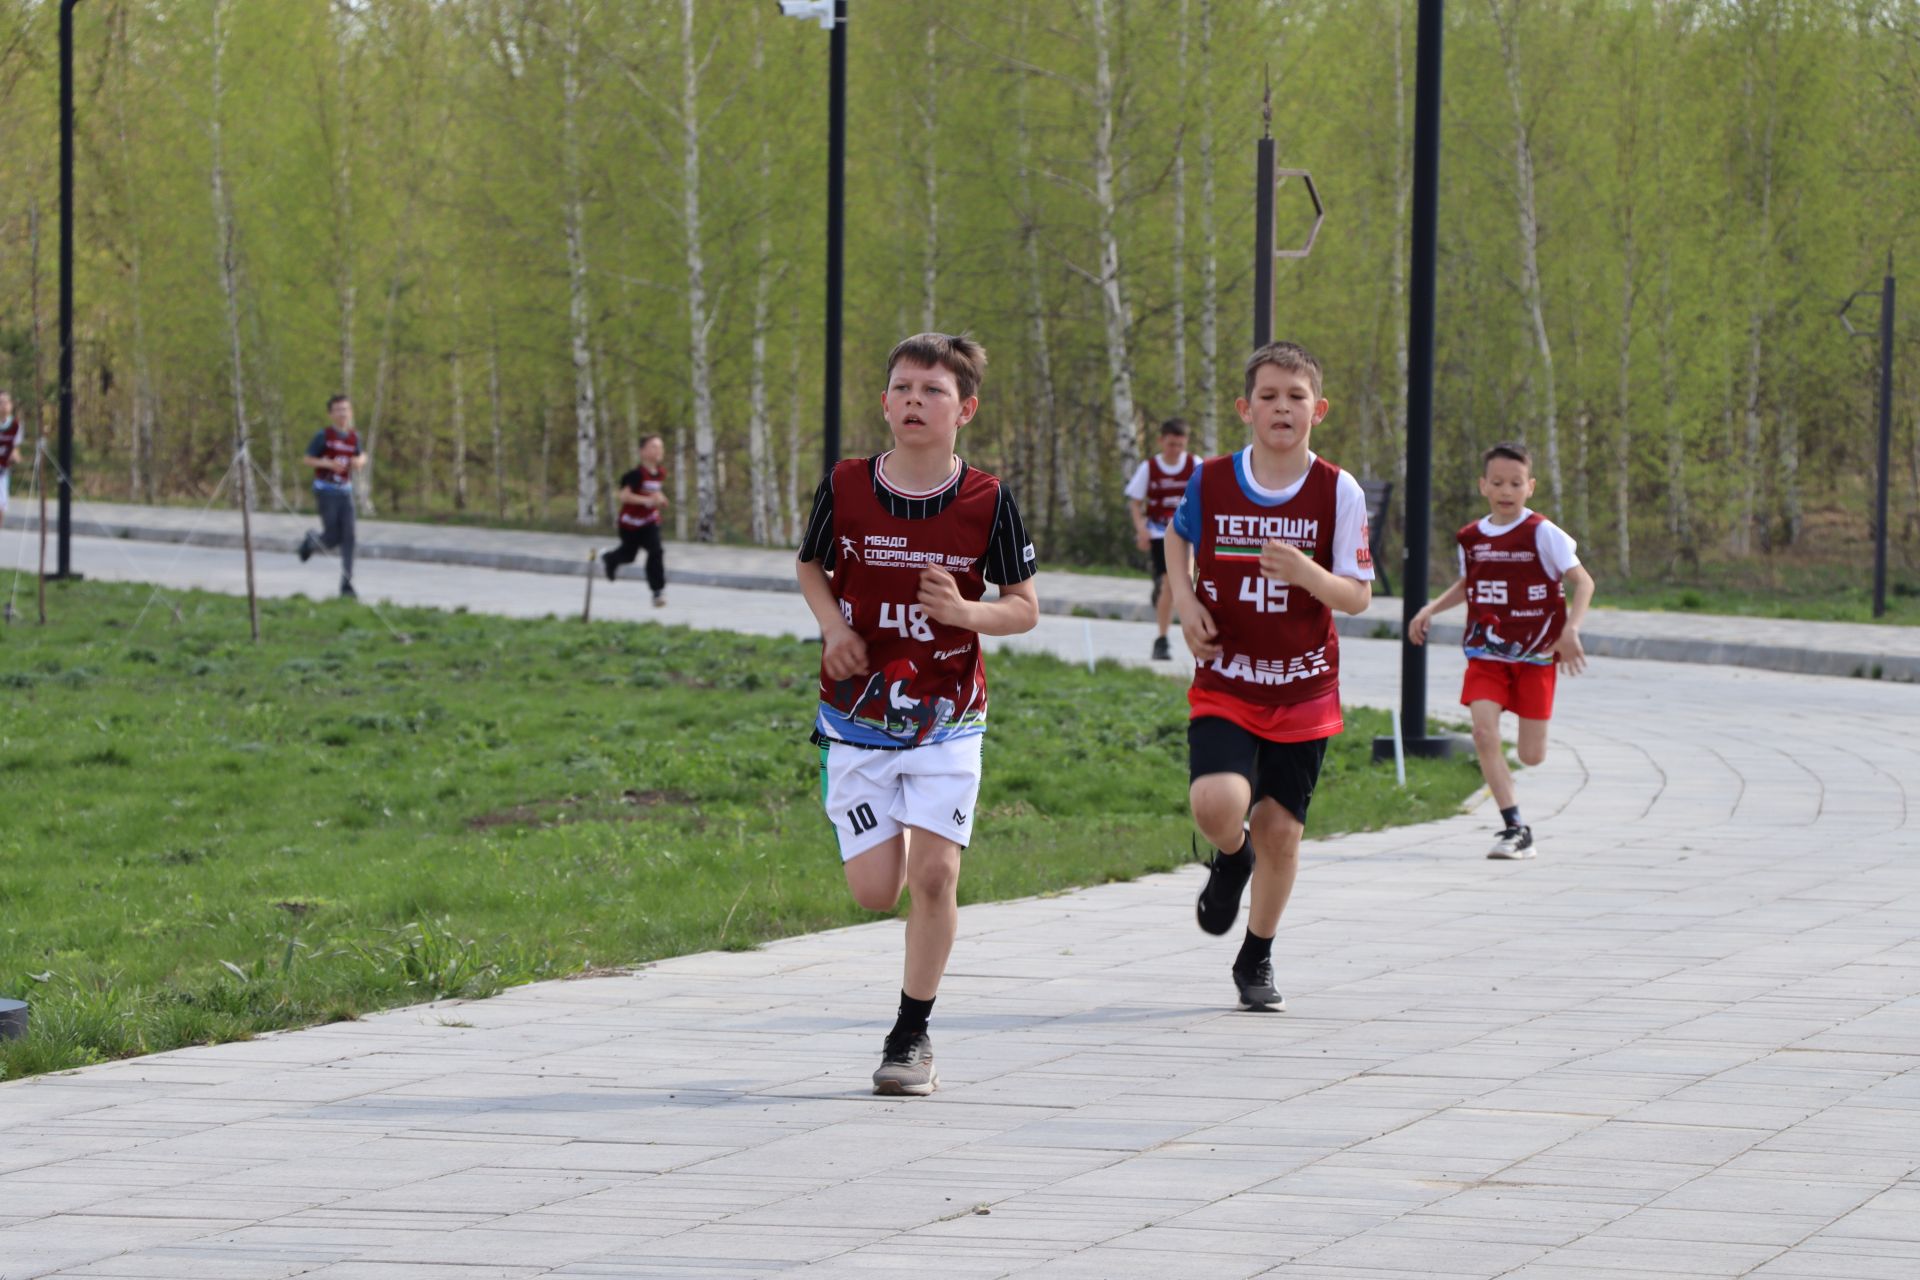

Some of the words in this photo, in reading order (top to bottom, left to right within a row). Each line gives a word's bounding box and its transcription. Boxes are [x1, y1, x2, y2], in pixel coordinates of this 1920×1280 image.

[1214, 514, 1318, 539] ТЕТЮШИ
[864, 535, 907, 548] МБУДО
[1239, 576, 1289, 613] 45
[1476, 580, 1508, 605] 55
[1528, 583, 1548, 601] 55
[879, 602, 935, 642] 48
[1196, 646, 1330, 686] LAMAX
[847, 802, 878, 836] 10
